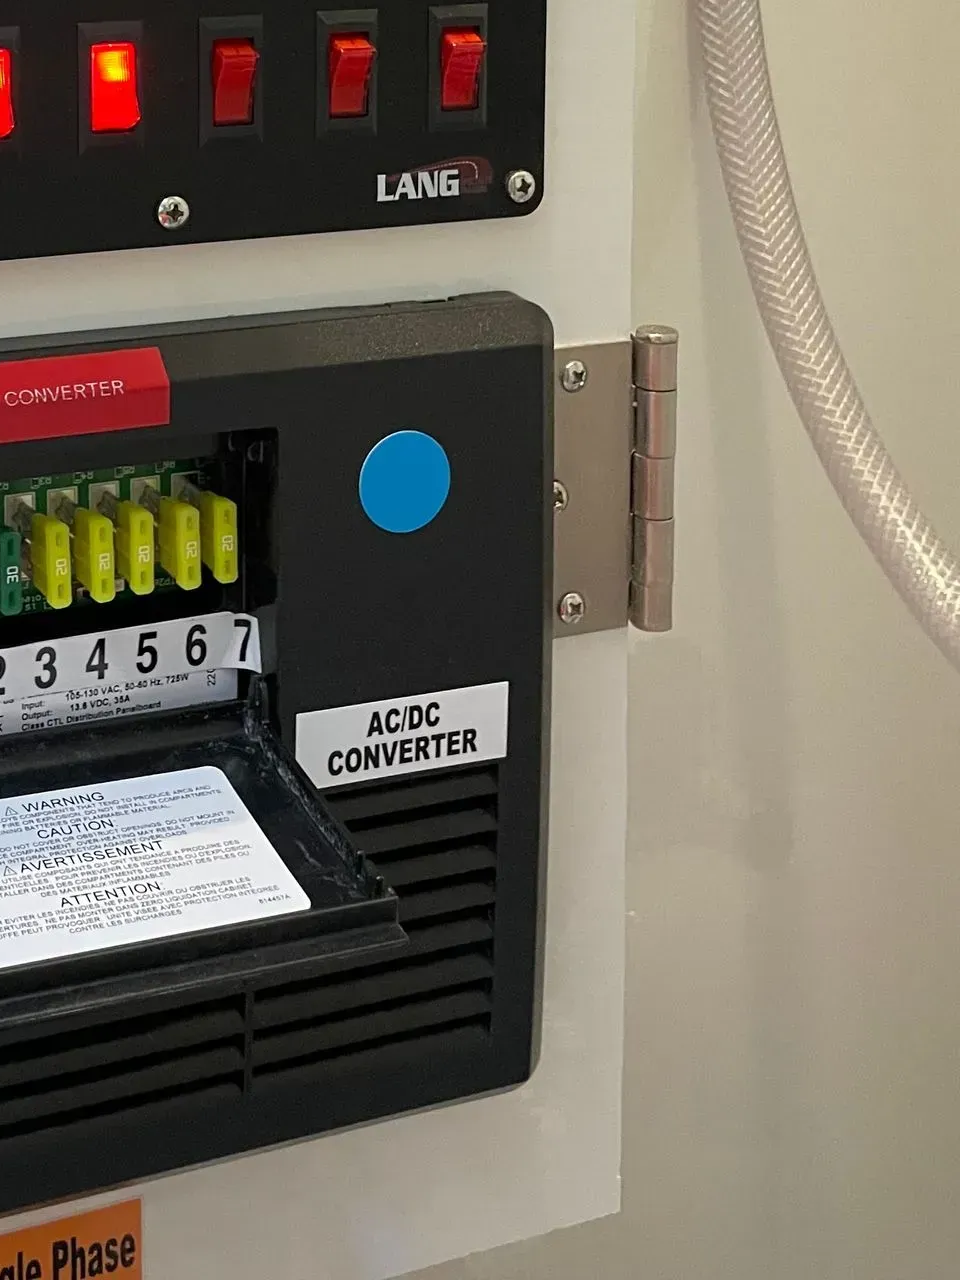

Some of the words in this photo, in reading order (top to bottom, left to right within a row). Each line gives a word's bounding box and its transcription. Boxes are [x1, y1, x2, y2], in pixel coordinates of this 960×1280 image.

[376, 168, 460, 203] LANG
[4, 379, 125, 406] CONVERTER
[34, 646, 57, 689] 3
[85, 638, 109, 680] 4
[136, 631, 158, 674] 5
[186, 624, 207, 666] 6
[233, 619, 252, 662] 7
[366, 701, 441, 738] AC/DC
[328, 728, 477, 776] CONVERTER
[21, 790, 105, 813] WARNING
[20, 839, 164, 874] AVERTISSEMENT
[52, 1233, 136, 1280] Phase
